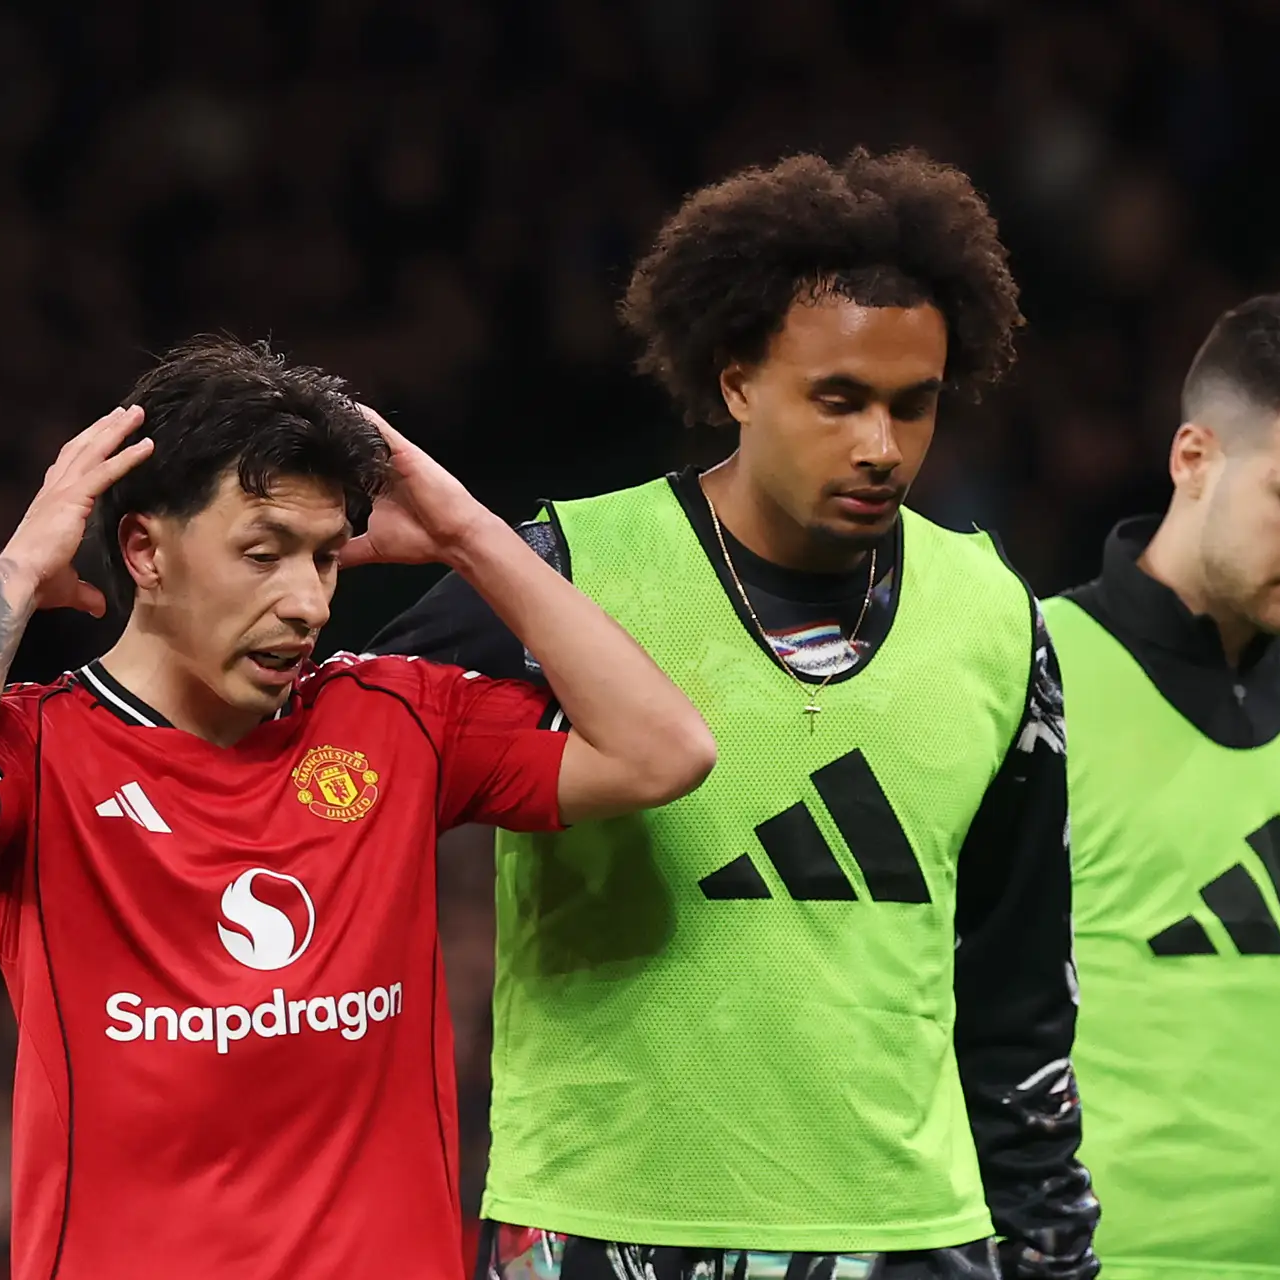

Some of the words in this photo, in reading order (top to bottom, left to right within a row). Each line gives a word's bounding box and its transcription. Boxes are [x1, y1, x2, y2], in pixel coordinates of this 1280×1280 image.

[299, 751, 362, 783] MANCHESTER
[326, 798, 371, 817] UNITED
[105, 982, 402, 1054] Snapdragon
